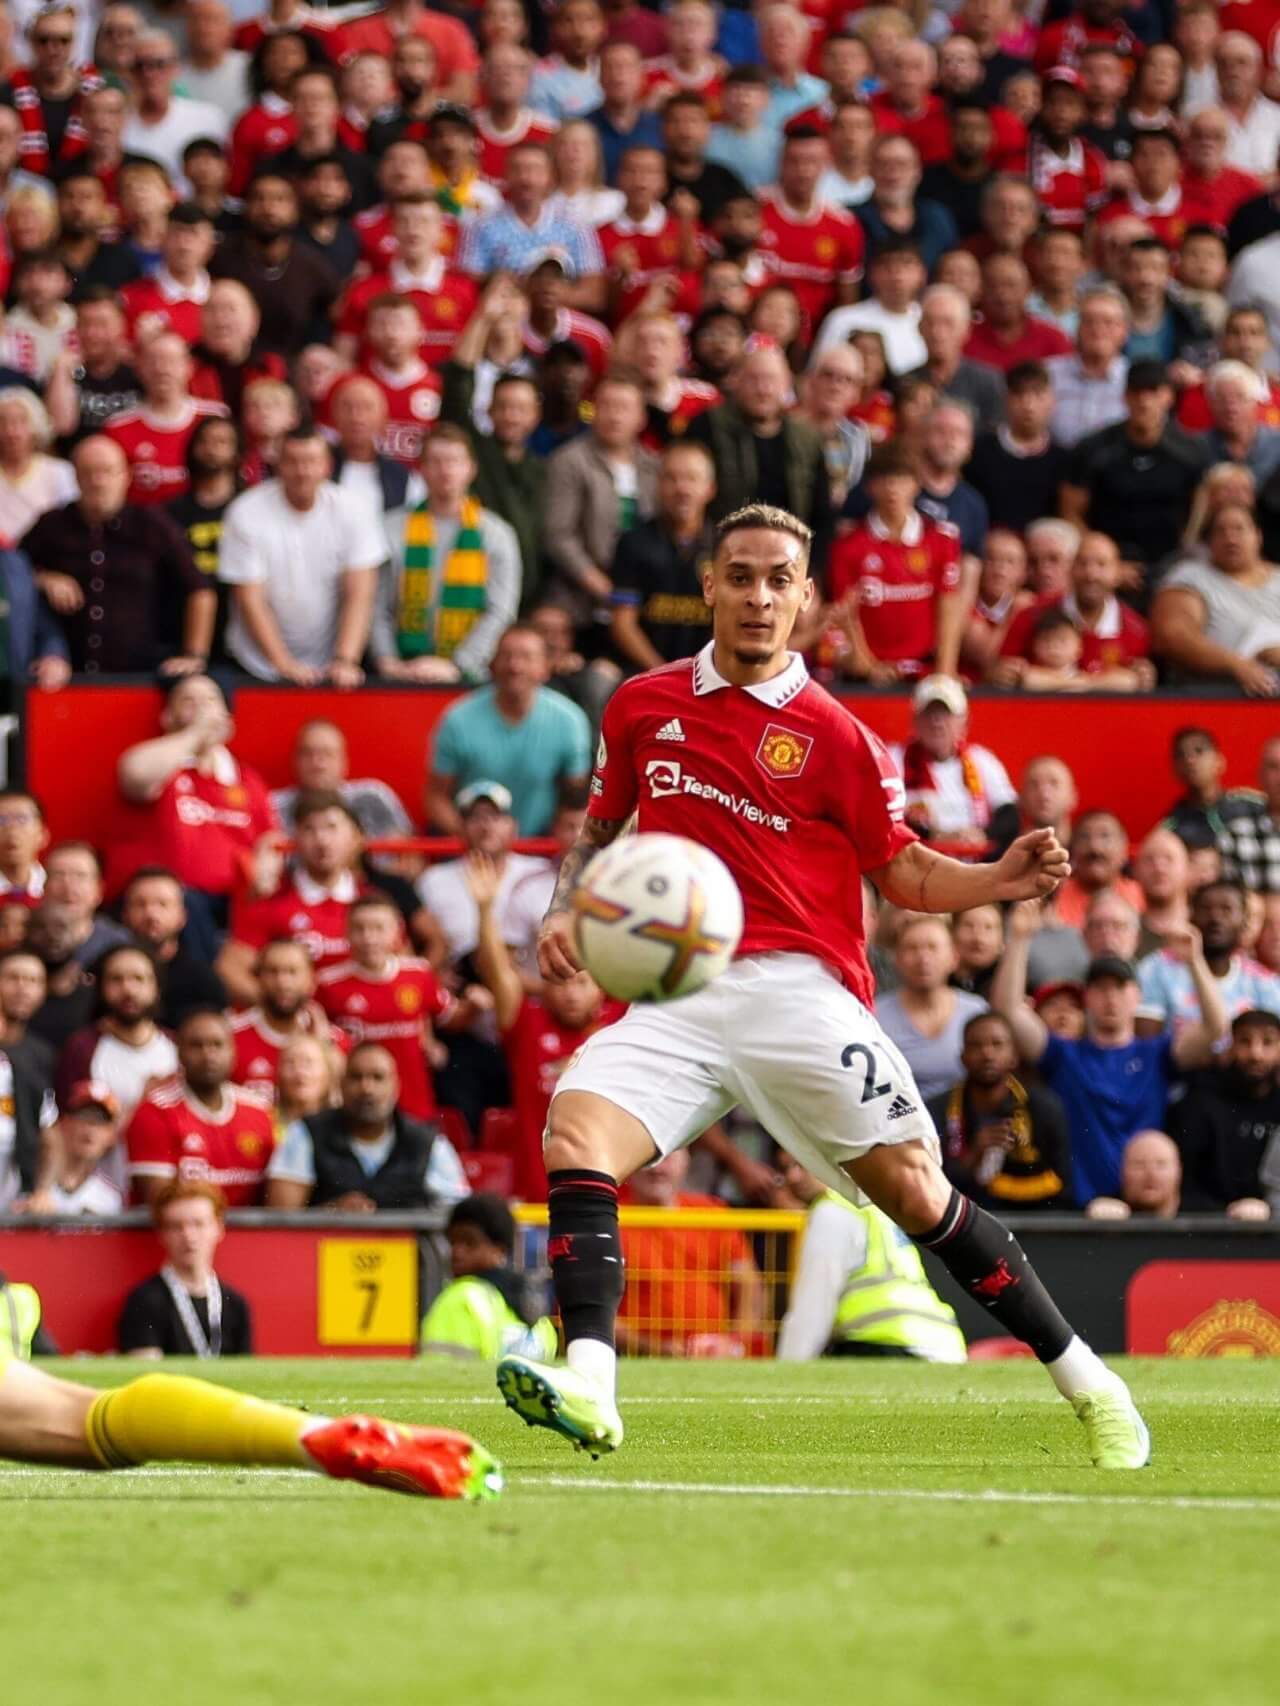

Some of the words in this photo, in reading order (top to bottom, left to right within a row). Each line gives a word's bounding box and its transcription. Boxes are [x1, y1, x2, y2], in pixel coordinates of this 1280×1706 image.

[655, 731, 686, 742] adidas
[681, 775, 793, 833] TeamViewer
[887, 1105, 918, 1121] adidas
[356, 1280, 380, 1334] 7
